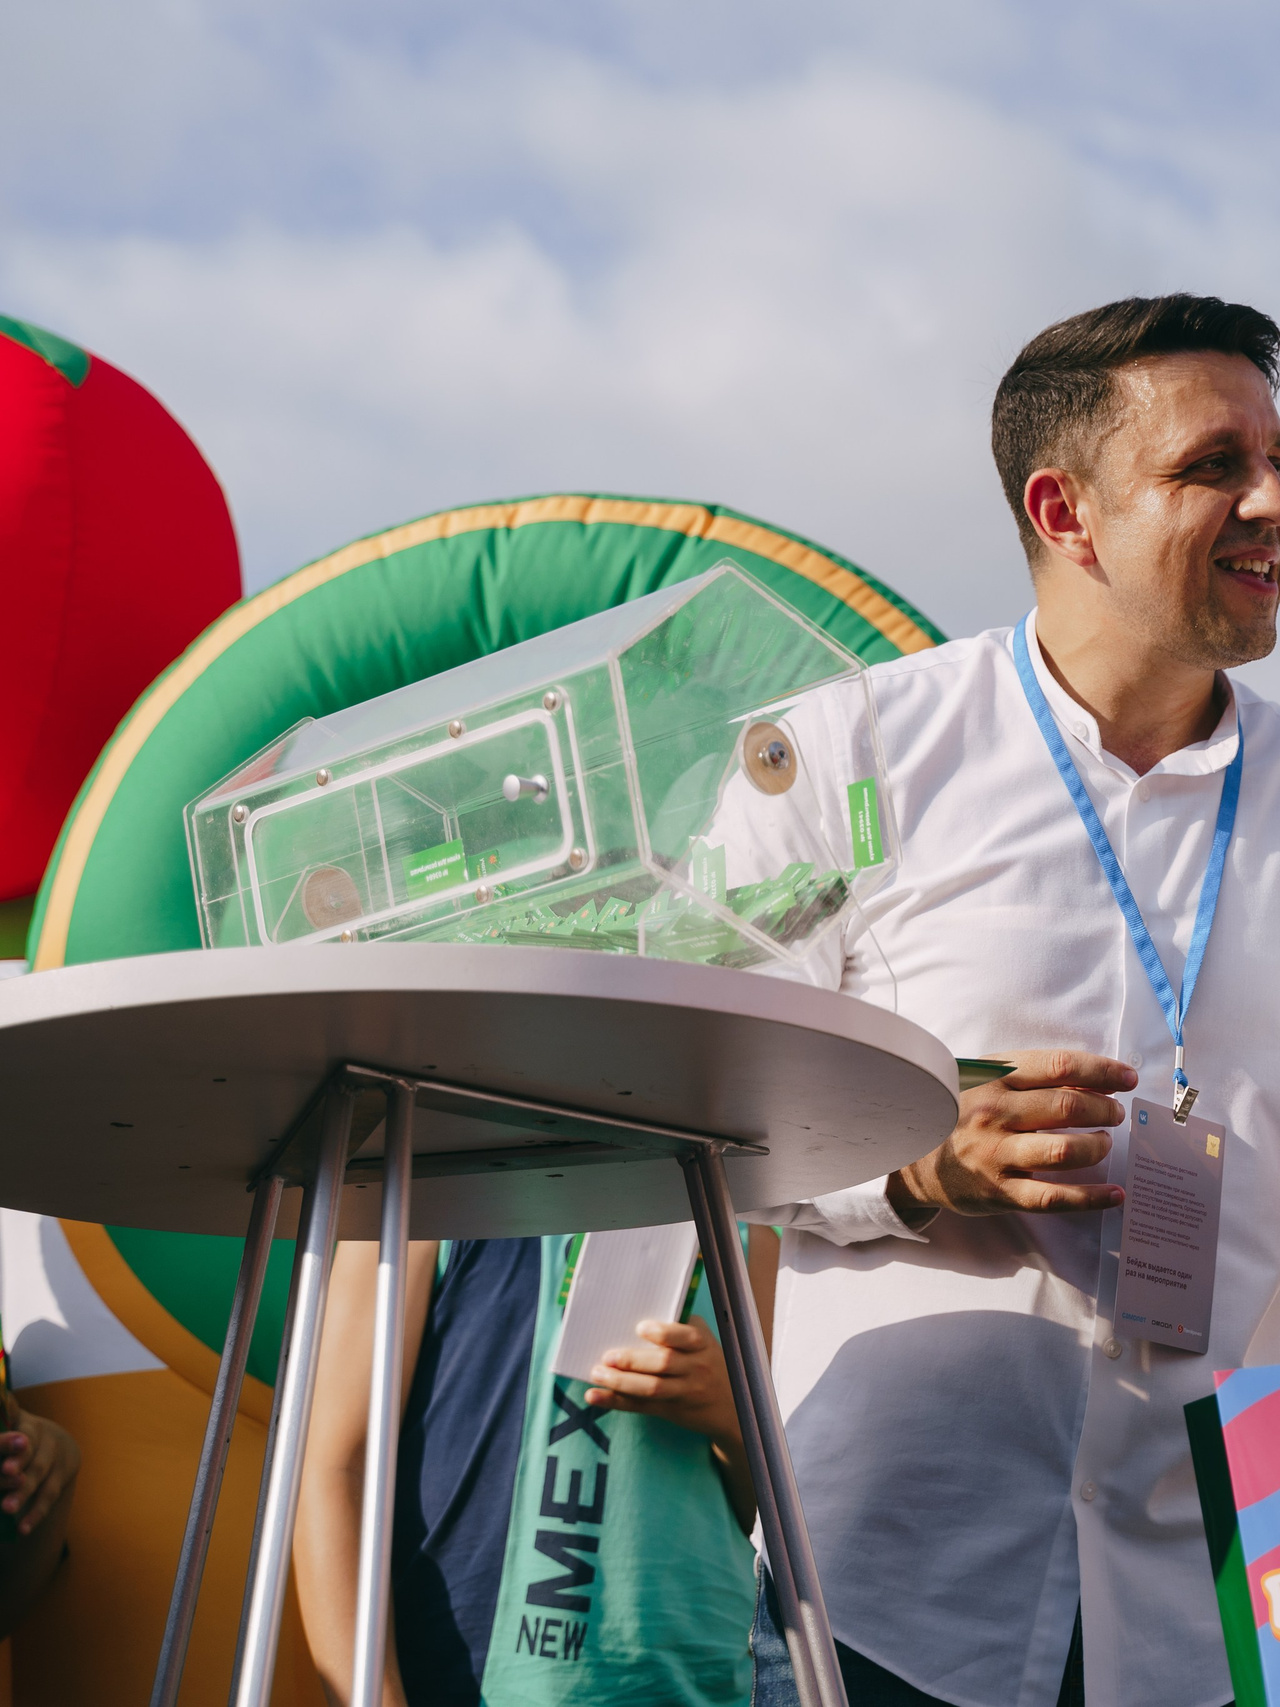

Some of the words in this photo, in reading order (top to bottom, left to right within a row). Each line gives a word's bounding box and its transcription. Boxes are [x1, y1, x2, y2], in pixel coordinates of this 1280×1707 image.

[1125, 1269, 1137, 1277] раз
[1137, 1271, 1146, 1280] на
[1146, 1274, 1188, 1290] мероприятие
[1126, 1256, 1147, 1269] Бейдж
[1148, 1263, 1177, 1276] выдается
[1177, 1270, 1193, 1281] один
[515, 1613, 589, 1662] NEW
